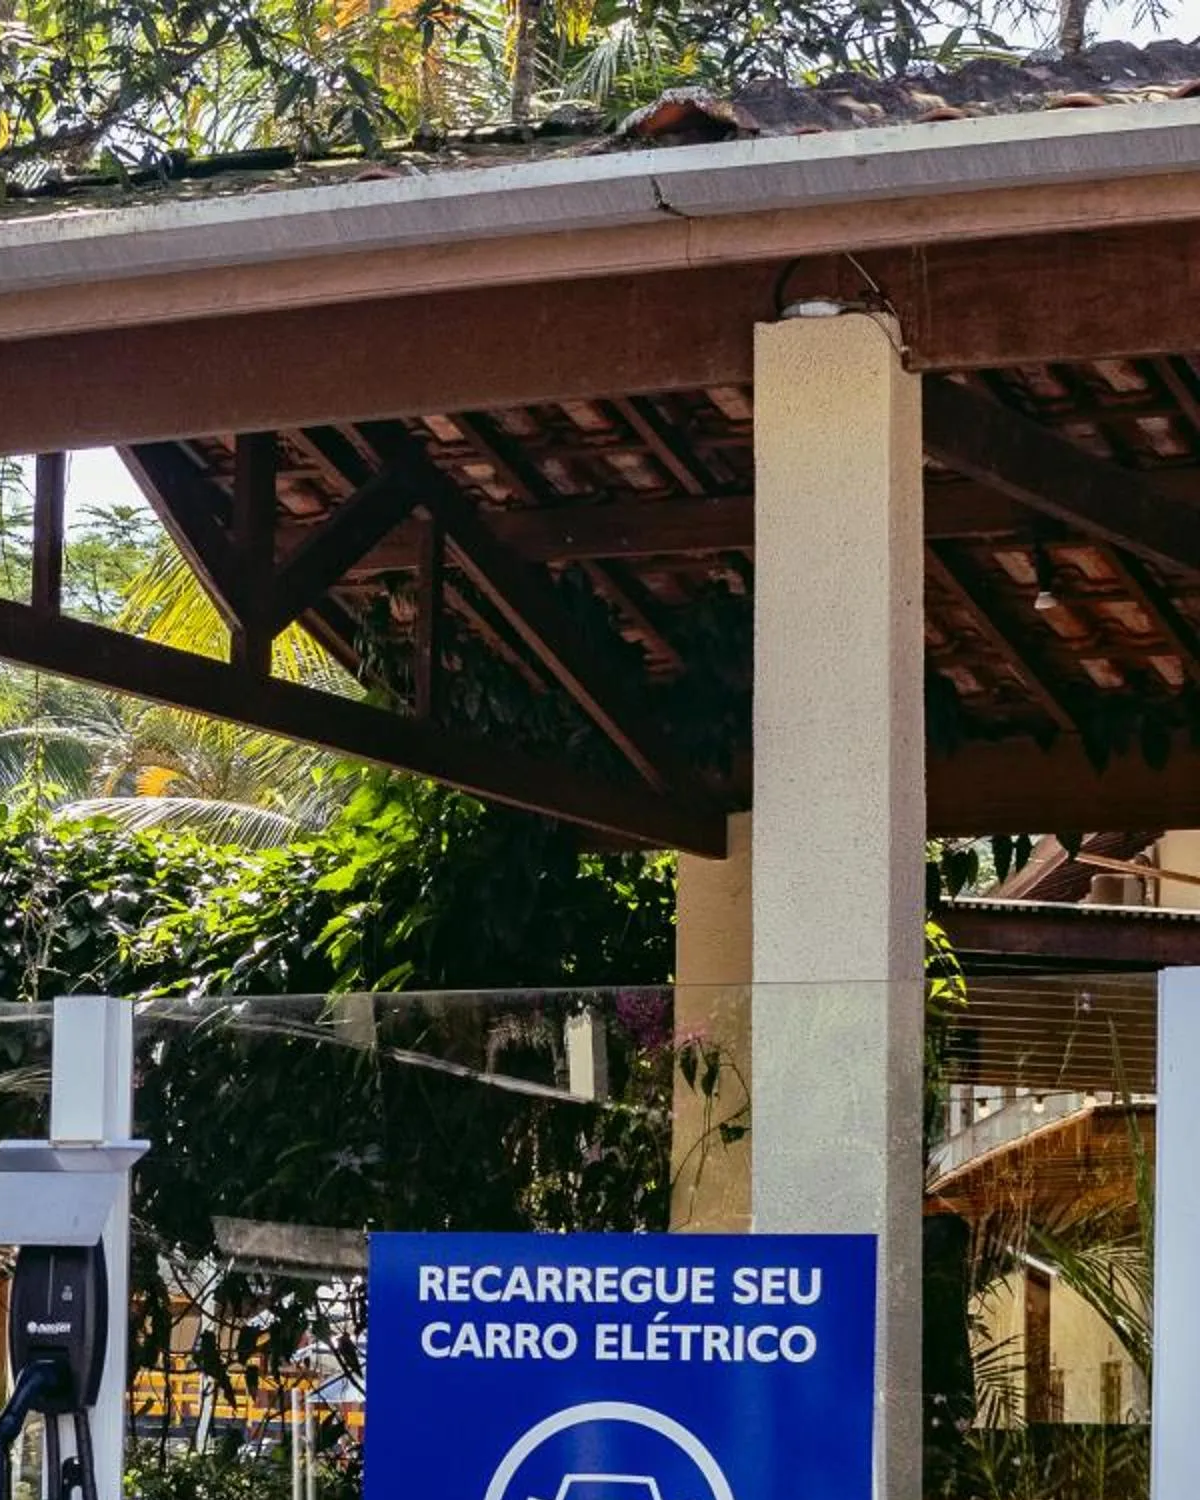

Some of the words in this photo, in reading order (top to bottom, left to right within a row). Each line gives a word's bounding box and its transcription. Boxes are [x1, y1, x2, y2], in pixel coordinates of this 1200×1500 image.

[418, 1265, 715, 1304] RECARREGUE
[732, 1266, 822, 1306] SEU
[420, 1321, 578, 1360] CARRO
[594, 1311, 818, 1364] ELÉTRICO
